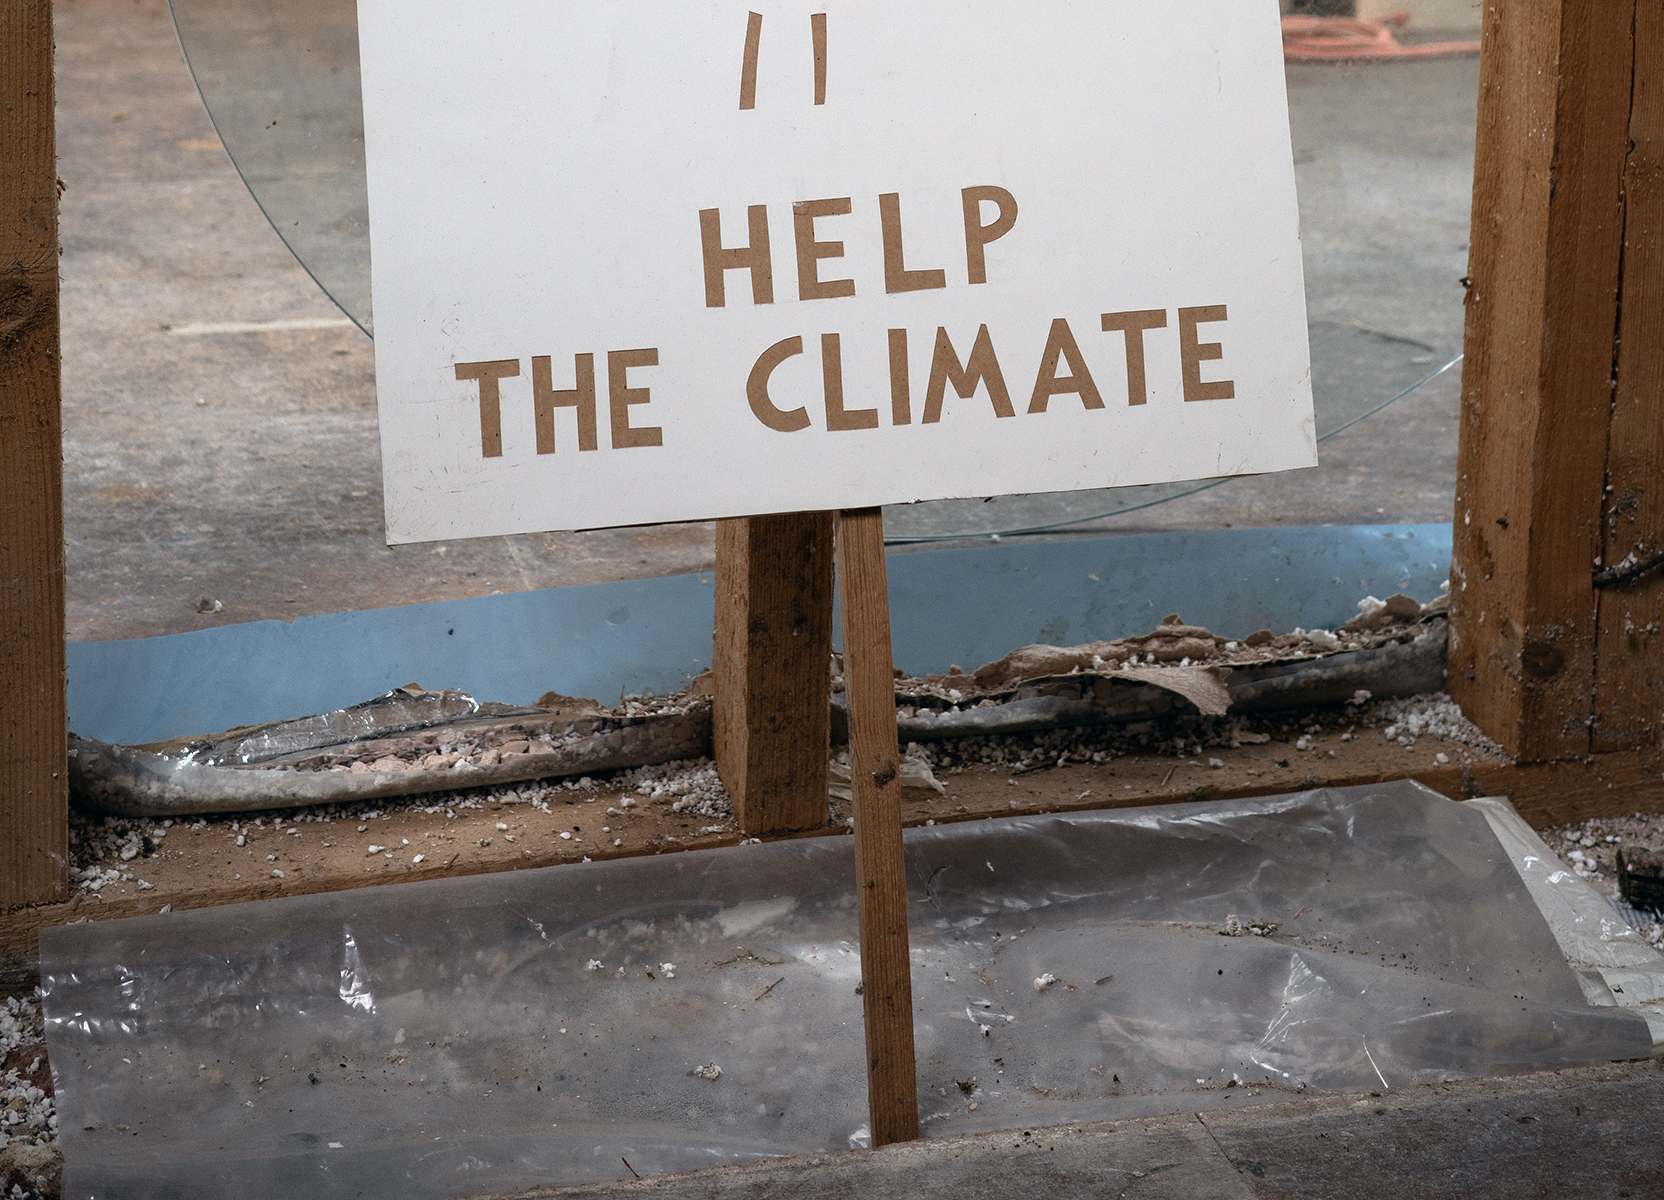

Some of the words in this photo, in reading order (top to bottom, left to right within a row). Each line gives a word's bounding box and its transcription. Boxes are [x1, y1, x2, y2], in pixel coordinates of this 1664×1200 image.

[699, 185, 1018, 308] HELP
[454, 348, 663, 458] THE
[746, 304, 1235, 432] CLIMATE
